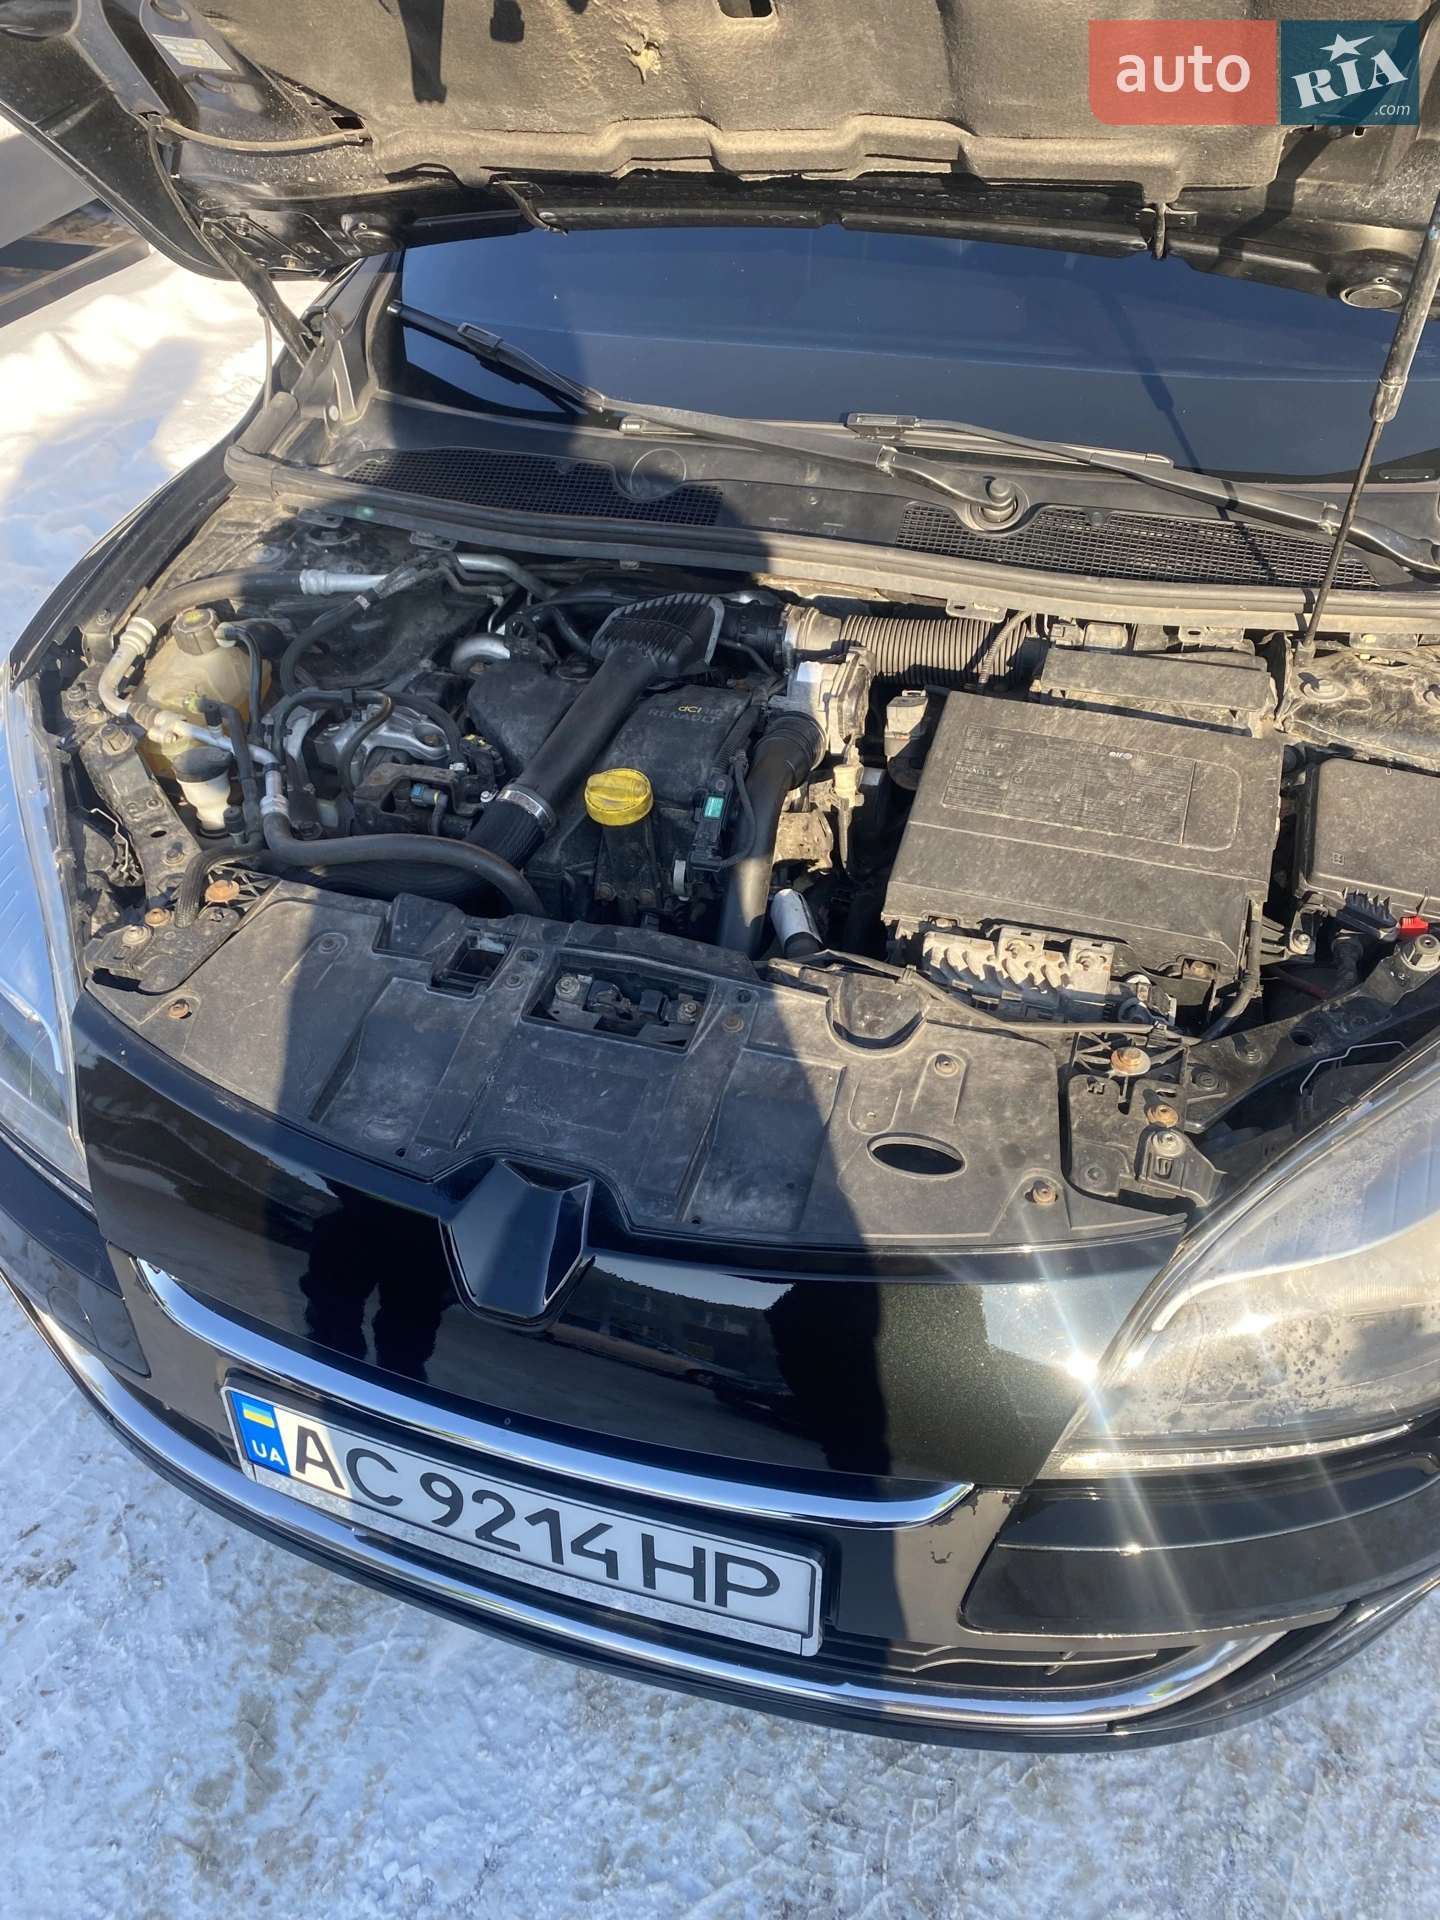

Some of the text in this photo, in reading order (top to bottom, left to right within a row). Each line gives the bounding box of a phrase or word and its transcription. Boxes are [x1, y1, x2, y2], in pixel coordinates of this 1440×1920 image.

[648, 708, 718, 724] RENAULT
[954, 764, 991, 776] RENAULT
[251, 1439, 285, 1466] UA
